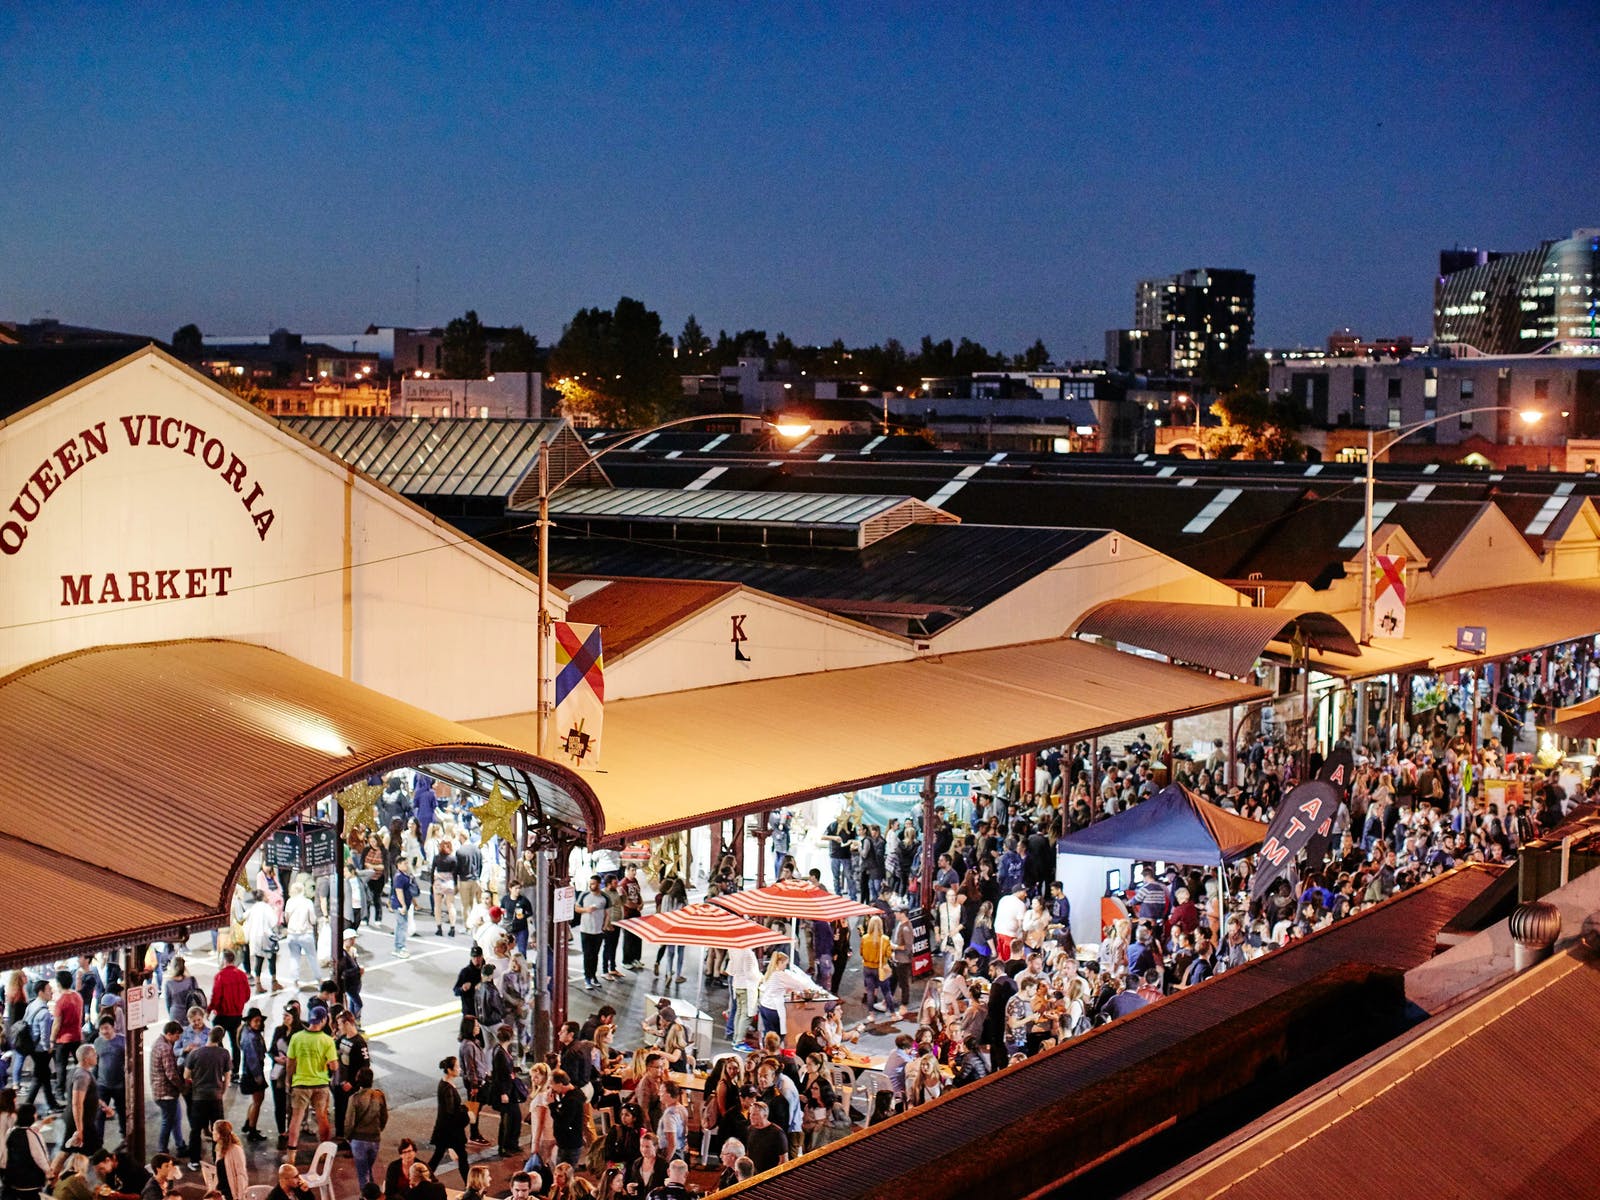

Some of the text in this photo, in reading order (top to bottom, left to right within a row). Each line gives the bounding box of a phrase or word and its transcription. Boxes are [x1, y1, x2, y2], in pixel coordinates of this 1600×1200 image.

[0, 414, 275, 555] QUEEN VICTORIA
[1111, 538, 1118, 554] J
[60, 566, 233, 607] MARKET
[730, 614, 748, 643] K
[1260, 797, 1323, 867] ATM
[912, 925, 927, 937] ATM
[912, 939, 929, 953] HERE
